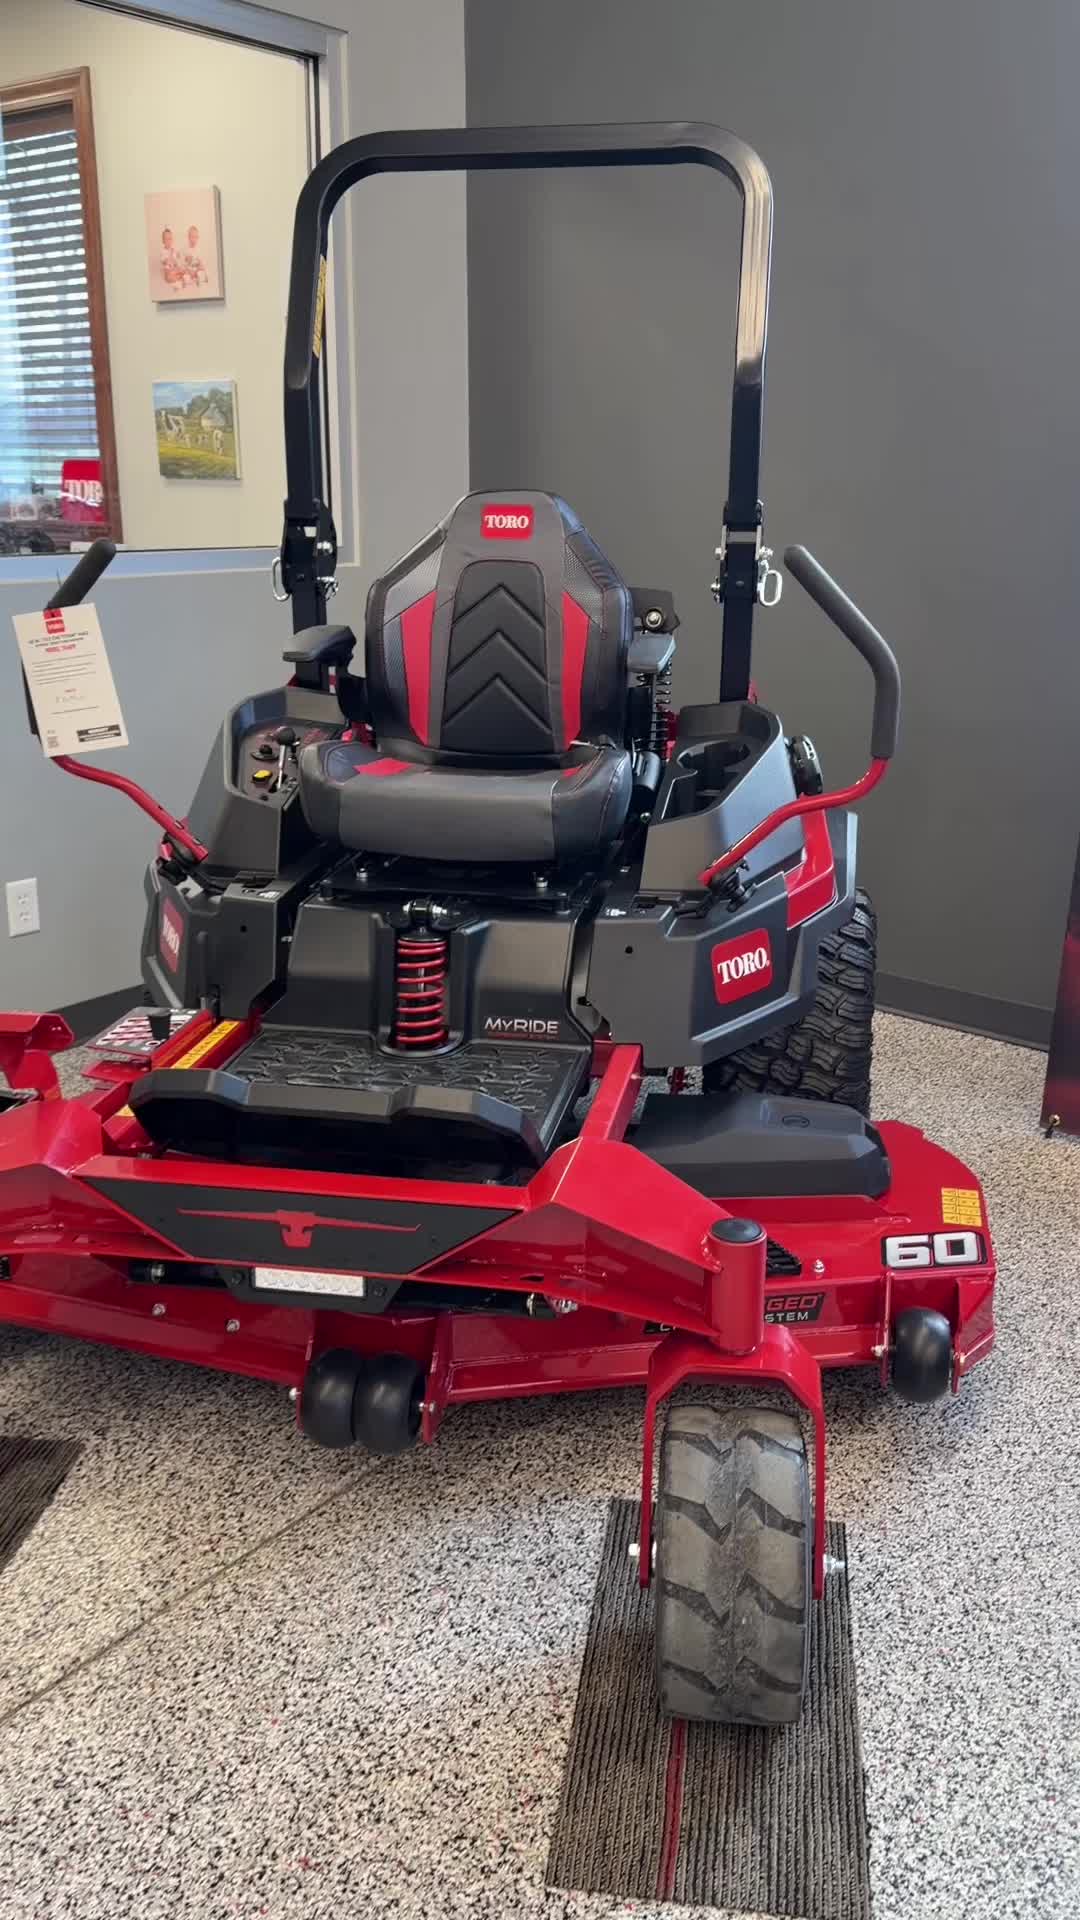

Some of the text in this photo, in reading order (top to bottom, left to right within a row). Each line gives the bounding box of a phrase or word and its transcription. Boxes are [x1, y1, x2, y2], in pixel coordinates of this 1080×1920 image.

[484, 514, 529, 529] TORO
[717, 947, 768, 985] TORO
[885, 1231, 979, 1269] 60
[766, 1295, 819, 1311] GED
[764, 1311, 809, 1323] STEM
